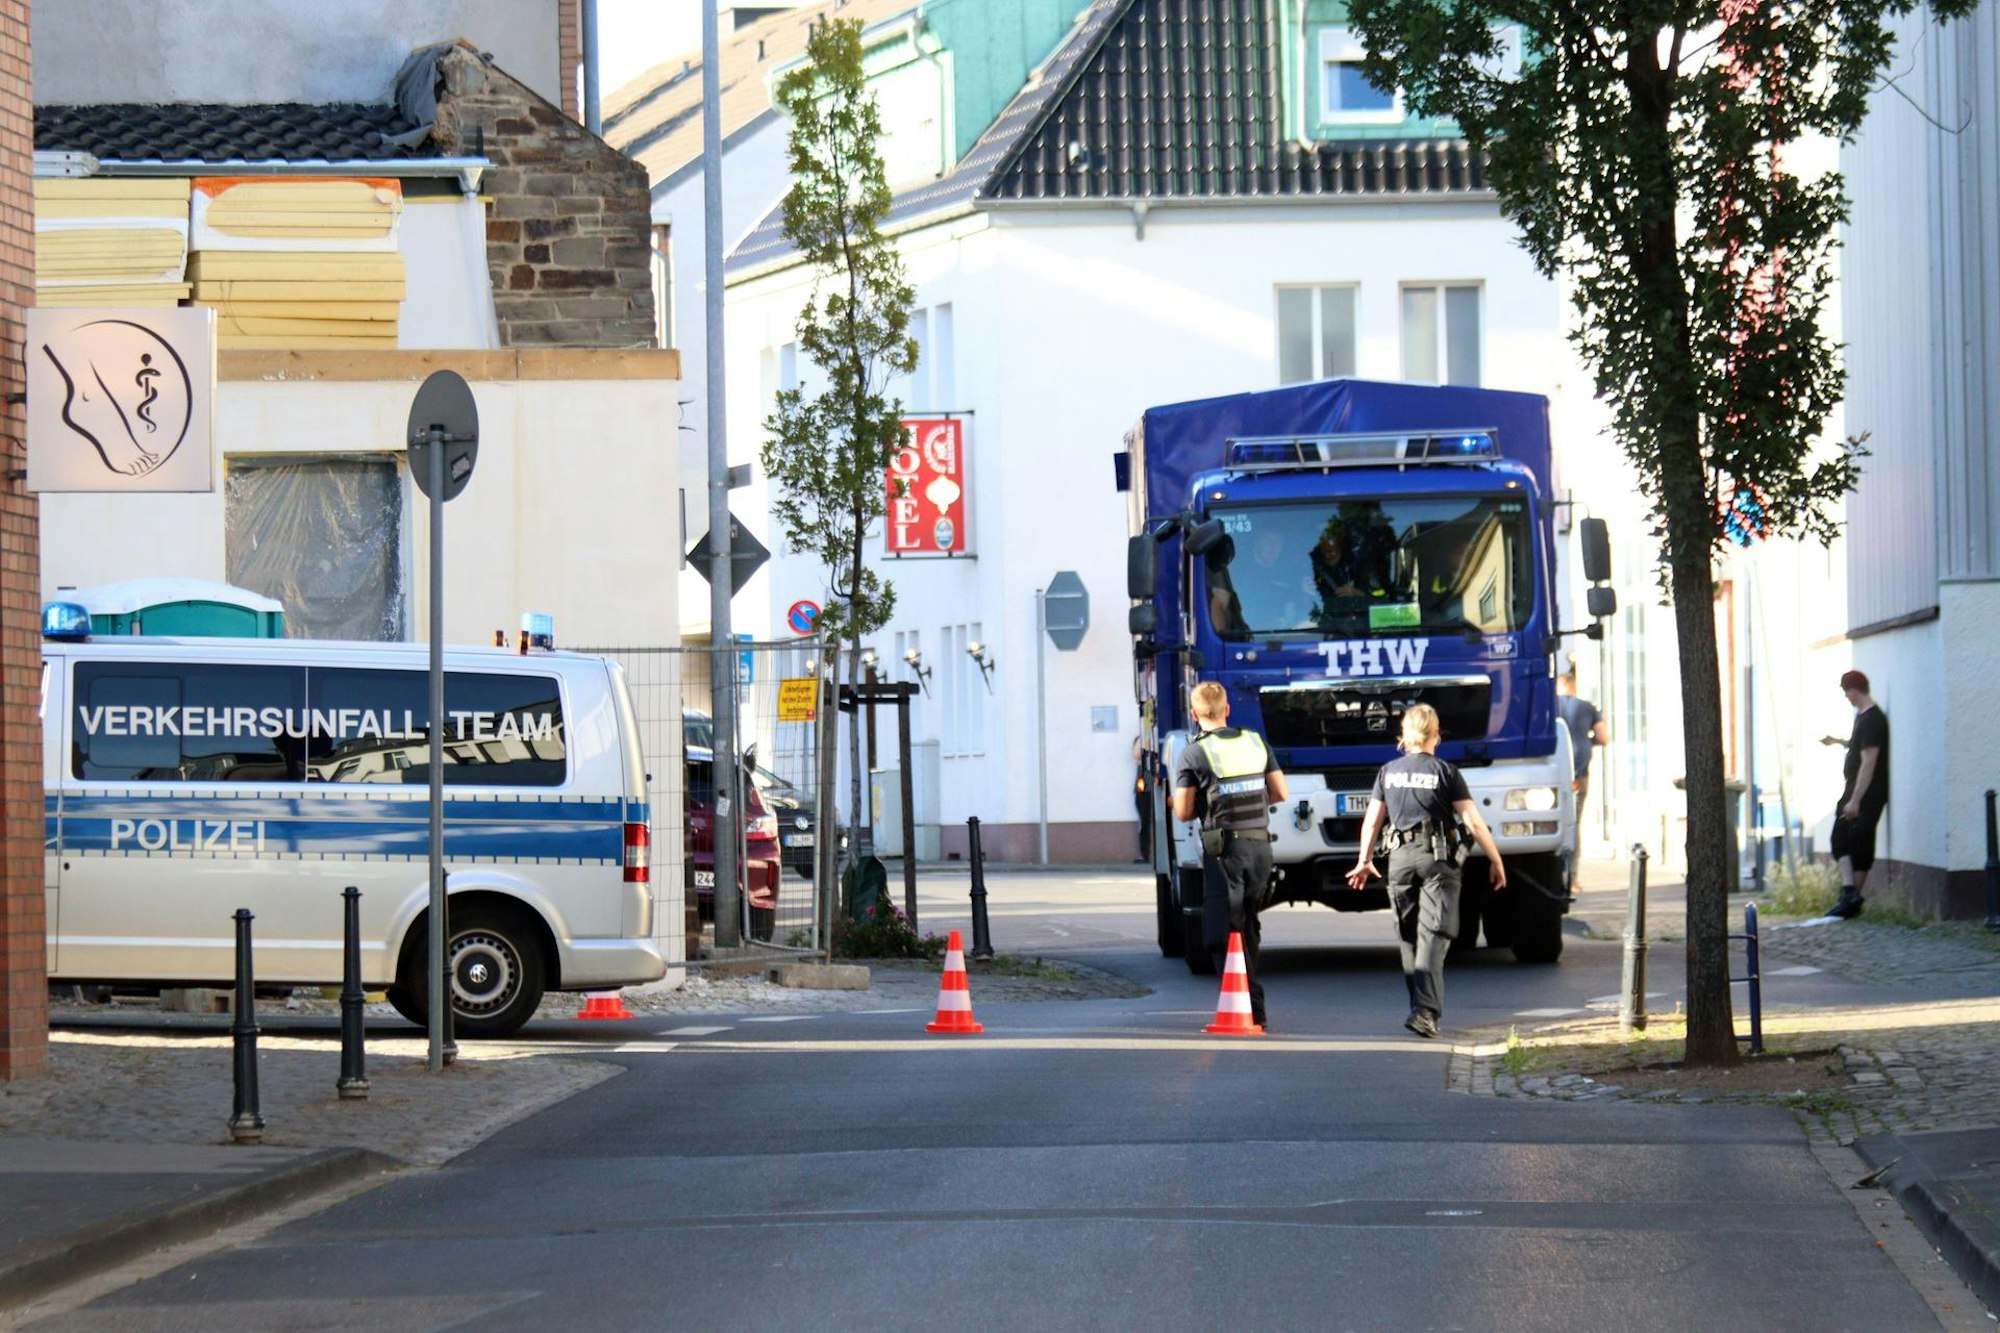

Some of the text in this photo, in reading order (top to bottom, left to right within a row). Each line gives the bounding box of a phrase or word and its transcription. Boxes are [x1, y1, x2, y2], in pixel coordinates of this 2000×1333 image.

[1317, 638, 1430, 677] THW
[79, 705, 552, 742] VERKEHRSUNFALL TEAM
[1385, 771, 1440, 790] POLIZEI
[110, 819, 266, 853] POLIZEI
[697, 872, 715, 885] 24
